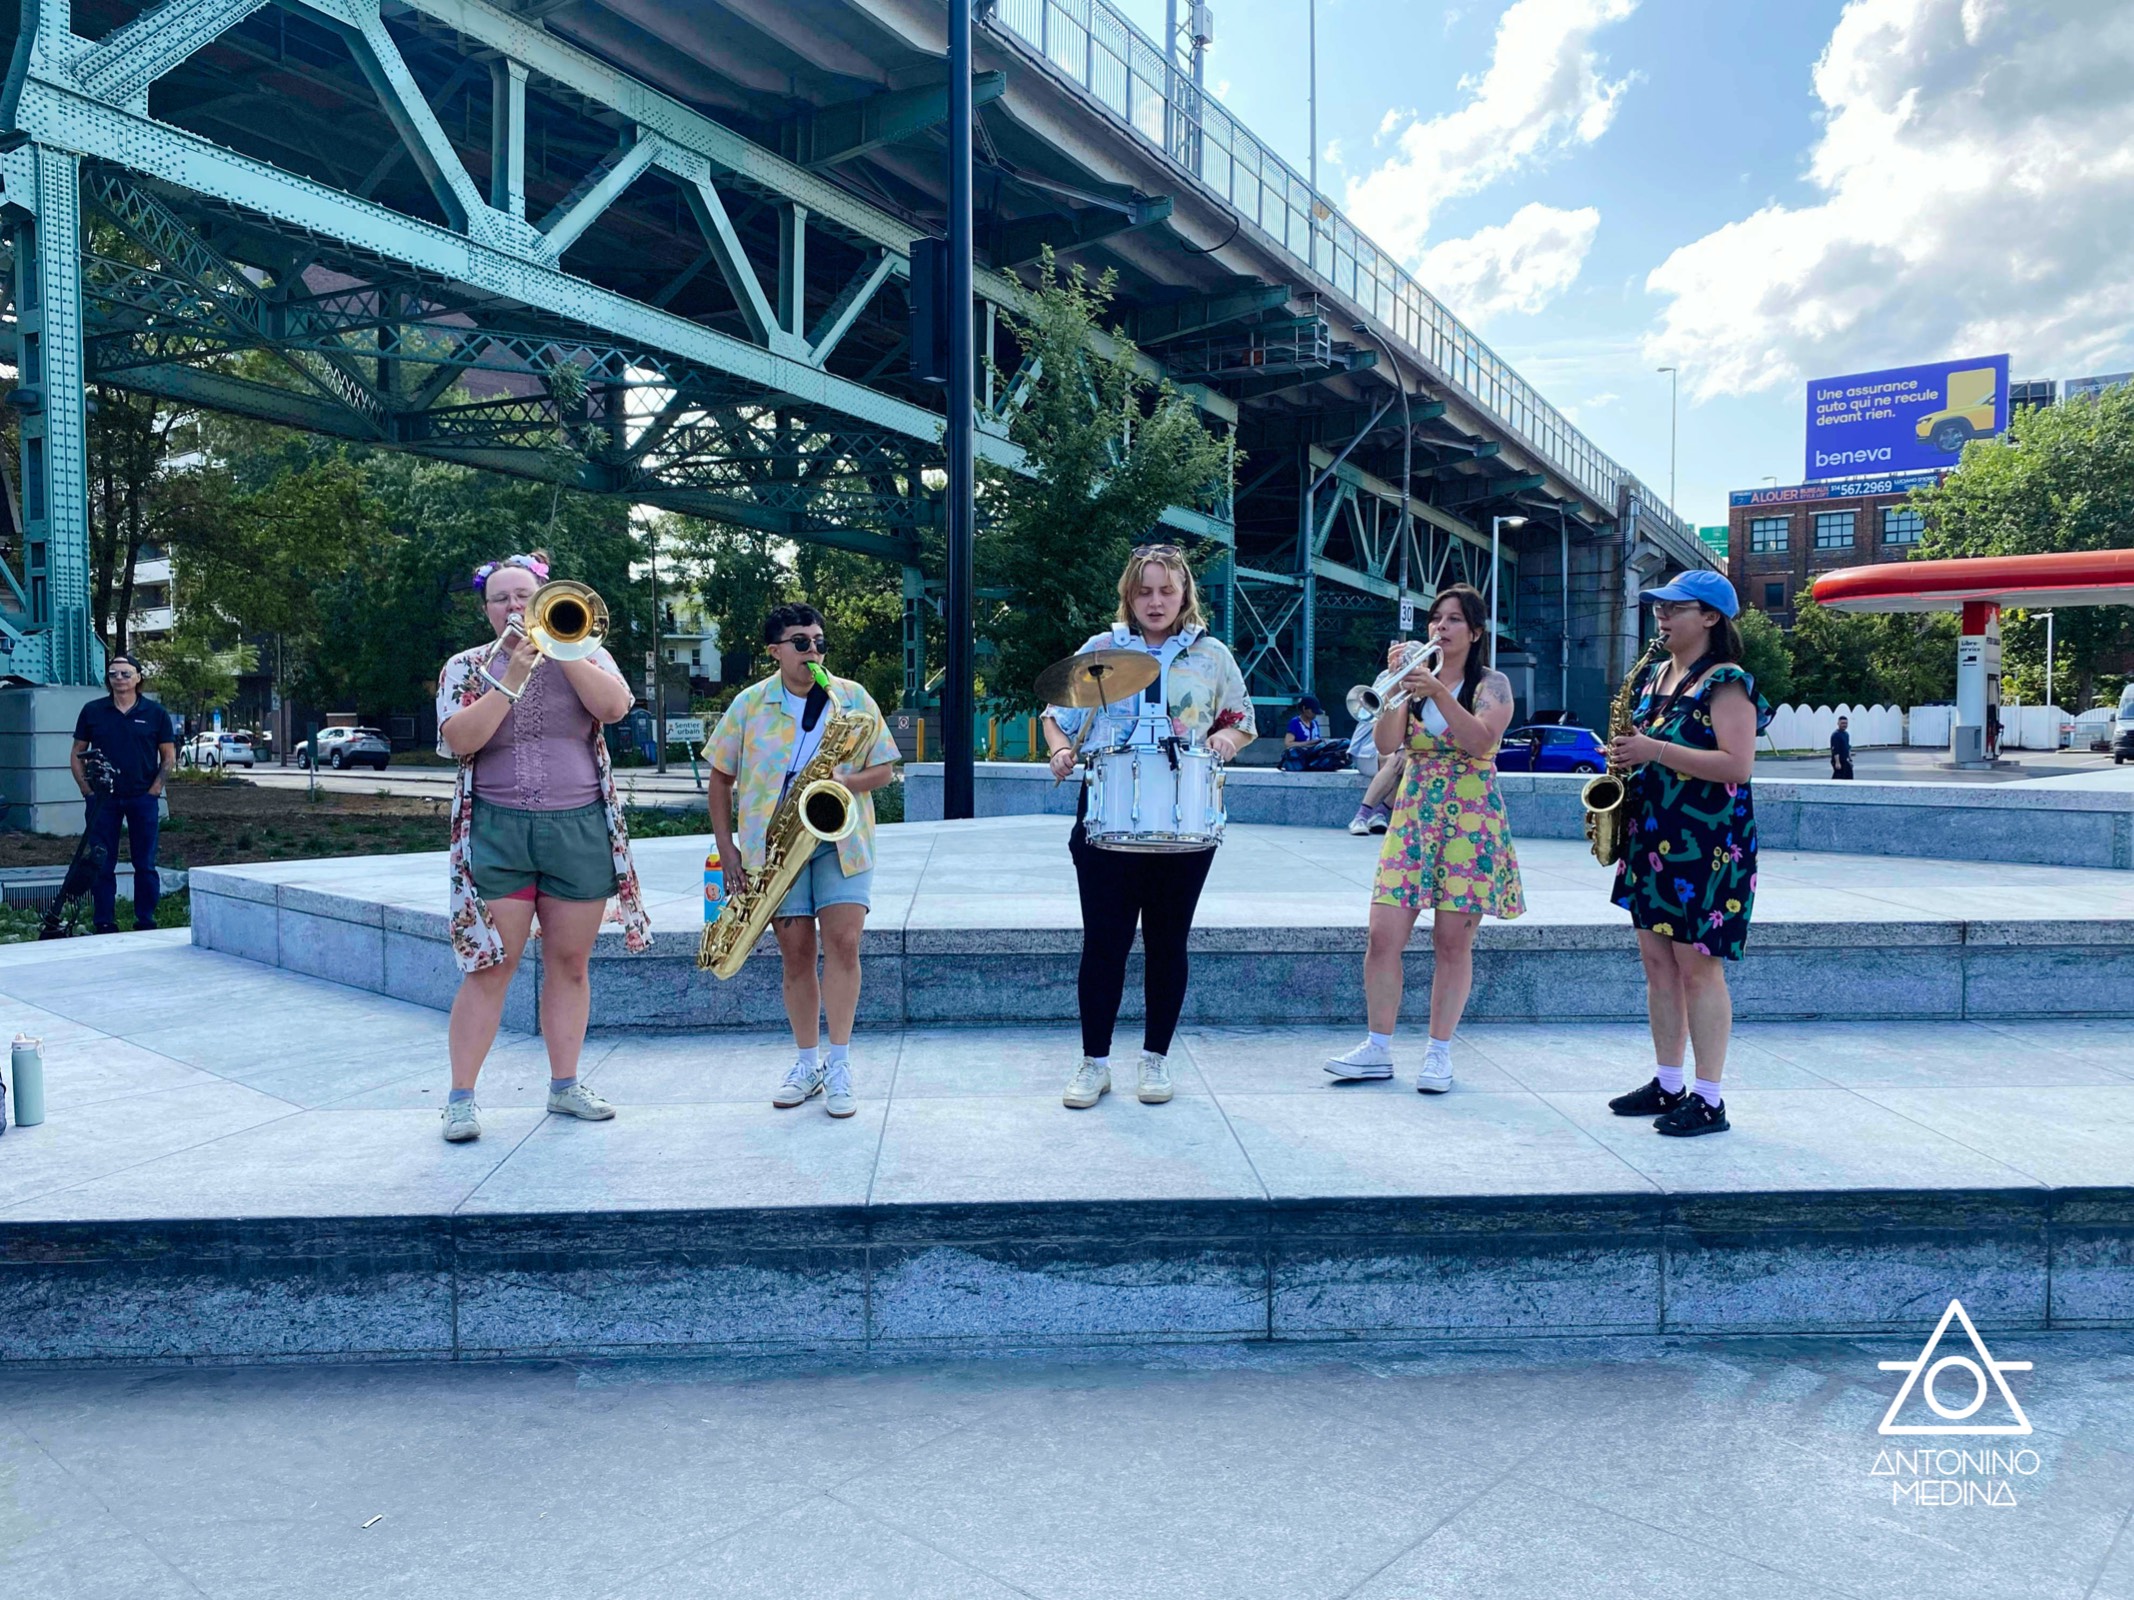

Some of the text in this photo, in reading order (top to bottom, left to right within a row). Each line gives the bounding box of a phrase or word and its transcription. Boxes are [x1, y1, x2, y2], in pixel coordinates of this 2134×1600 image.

[1817, 380, 1918, 401] Une assurance
[1816, 388, 1939, 414] auto qui ne recule
[1816, 408, 1896, 426] devant rien.
[1815, 447, 1892, 467] beneva
[1760, 489, 1799, 503] LOUER
[1840, 480, 1893, 496] 567.2969
[1401, 605, 1412, 622] 30
